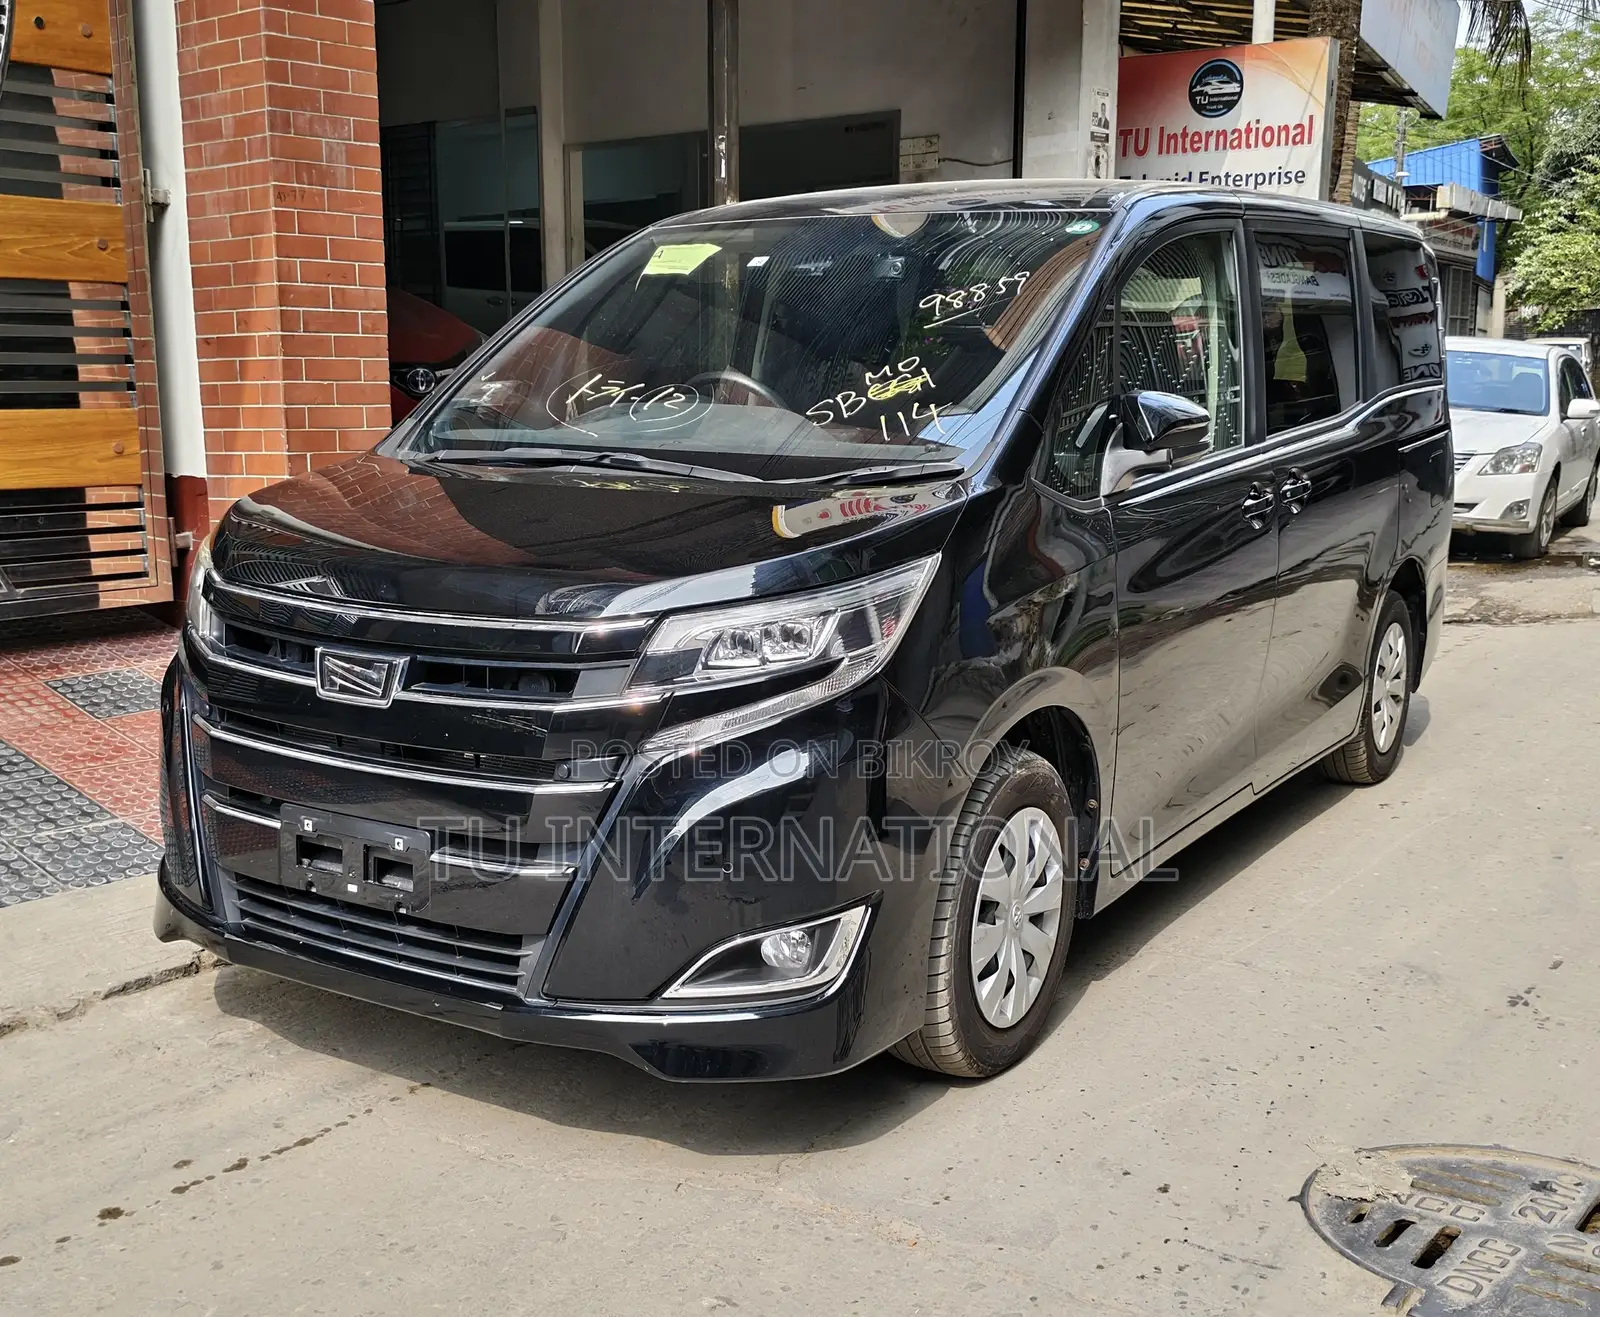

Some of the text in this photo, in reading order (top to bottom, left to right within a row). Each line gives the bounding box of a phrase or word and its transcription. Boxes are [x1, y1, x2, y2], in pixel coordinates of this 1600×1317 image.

[1195, 96, 1209, 105] TU
[1119, 115, 1314, 158] TU International
[1198, 166, 1305, 190] Enterprise
[919, 271, 1030, 316] 98859
[879, 401, 953, 442] 114
[1436, 1238, 1521, 1298] DNCC
